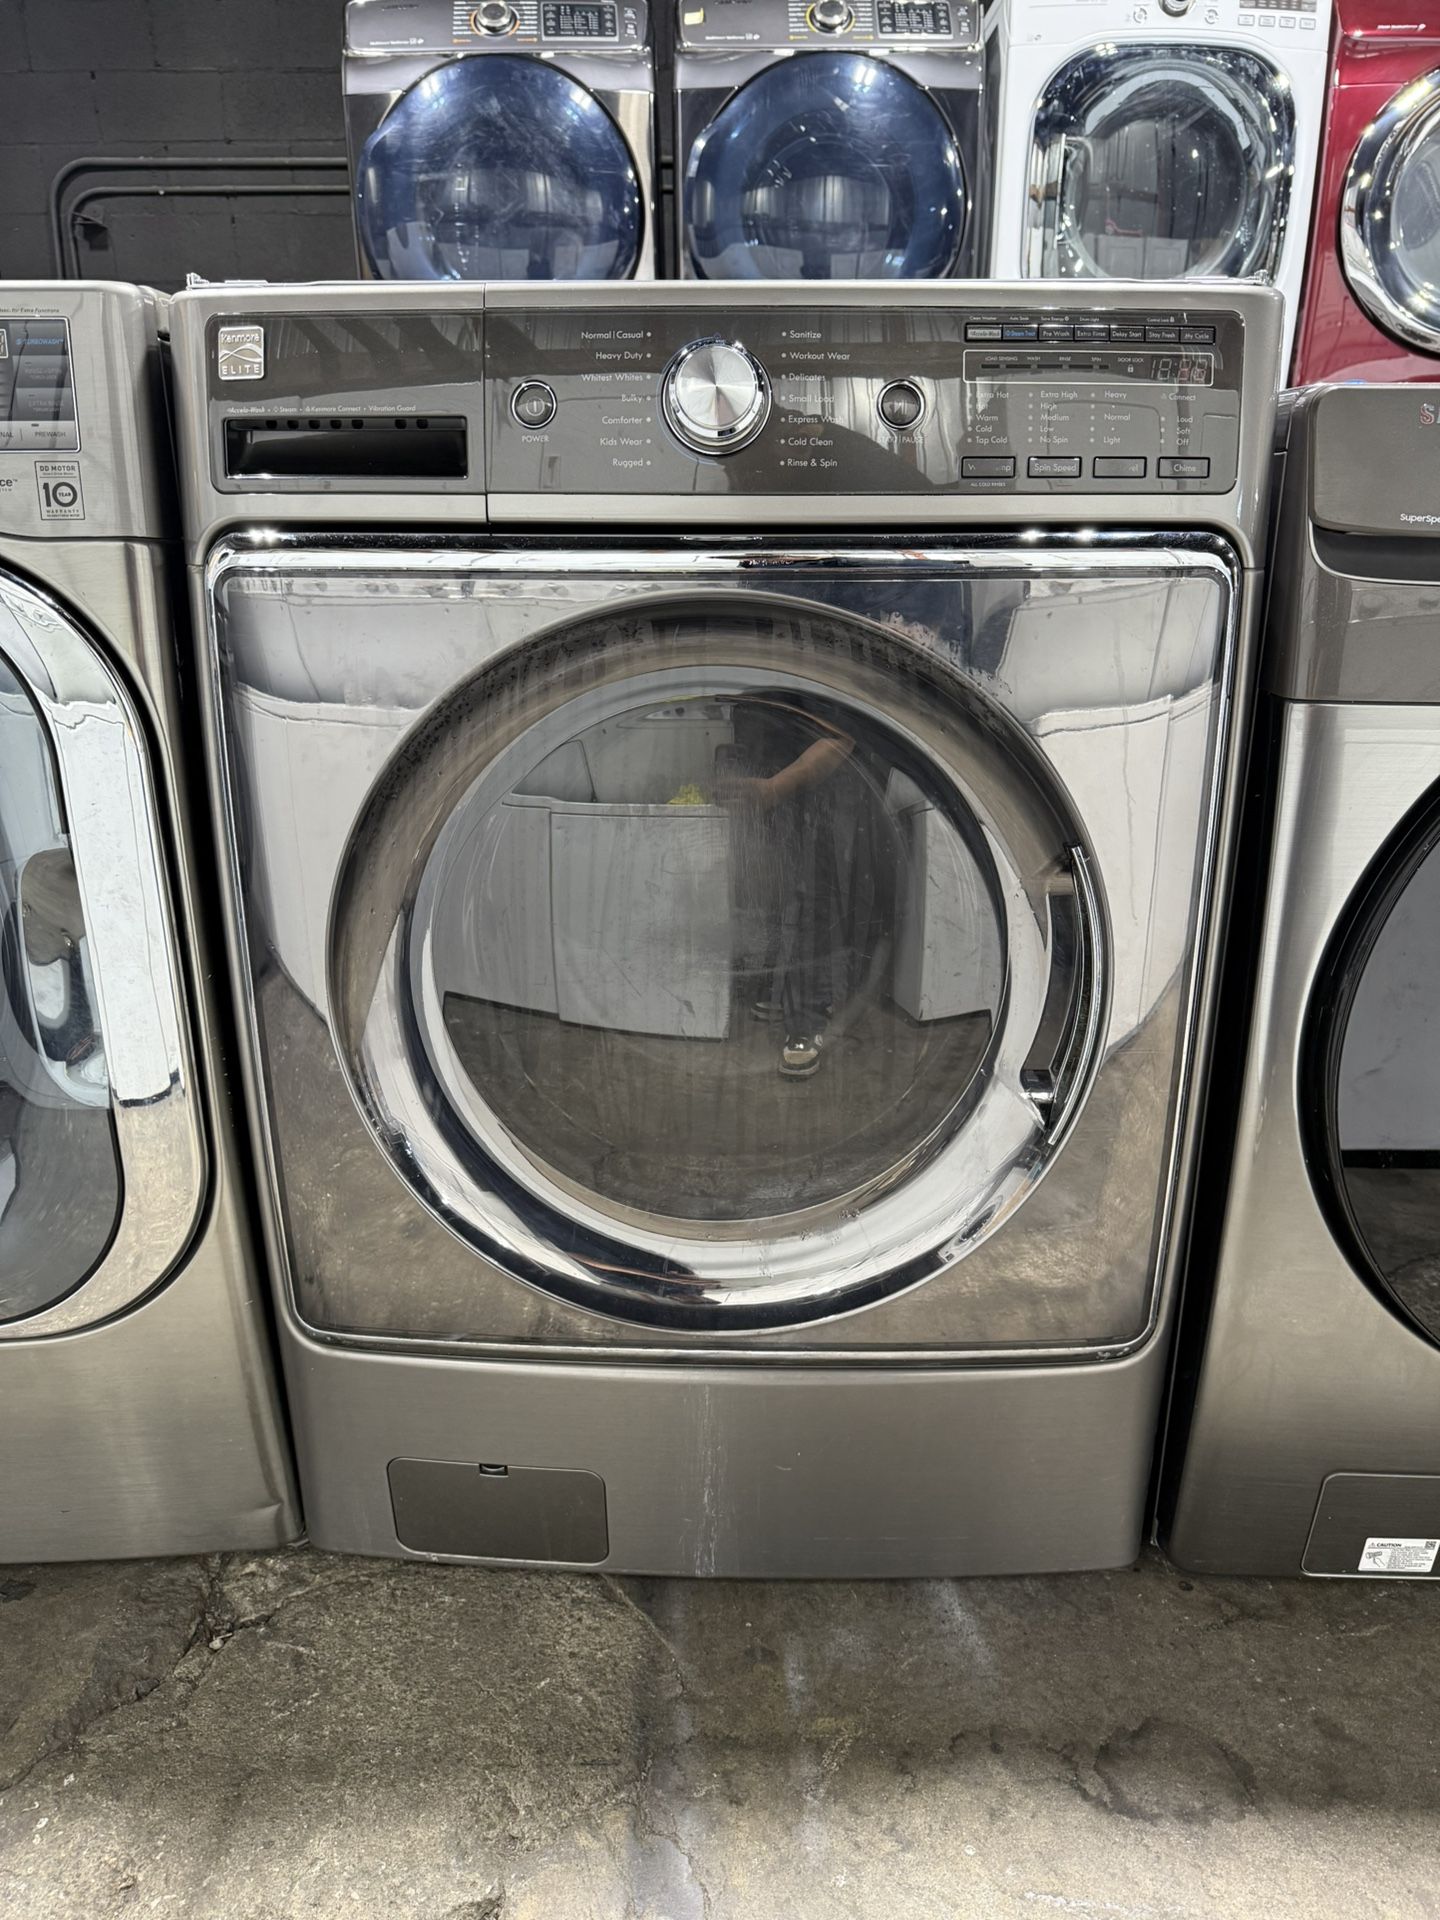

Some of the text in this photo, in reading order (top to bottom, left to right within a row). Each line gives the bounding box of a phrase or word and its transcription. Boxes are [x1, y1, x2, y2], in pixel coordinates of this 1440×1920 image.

[220, 333, 260, 343] Kenmore
[581, 330, 644, 339] Normal Casual
[790, 330, 822, 339] Sanitize
[595, 351, 643, 360] Heavy Duty
[790, 351, 850, 360] Workout Wear
[222, 364, 260, 375] ELITE
[614, 373, 643, 381] Whites
[789, 373, 826, 381] Delicates
[621, 394, 643, 403] Bulky
[789, 394, 812, 402] Small
[996, 391, 1009, 399] Hot
[1040, 390, 1078, 400] Extra High
[1104, 390, 1128, 399] Heavy
[1168, 392, 1197, 400] Connect
[1040, 402, 1058, 411] High
[602, 416, 643, 424] Comforter
[788, 415, 818, 424] Express
[1040, 413, 1070, 421] Medium
[1176, 415, 1194, 423] Loud
[975, 424, 993, 433] Cold
[1040, 424, 1055, 432] Low
[1176, 427, 1191, 435] Soft
[521, 435, 550, 443] POWER
[600, 437, 643, 446] Kids Wear
[788, 437, 833, 446] Cold Clean
[975, 435, 1008, 446] Tap Cold
[1039, 435, 1069, 445] No Spin
[1103, 435, 1121, 445] Light
[1176, 438, 1190, 446] Off
[612, 458, 644, 468] Rugged
[787, 459, 838, 469] Rinse & Spin
[1034, 463, 1077, 472] Spin Speed
[1173, 463, 1197, 472] Chime
[43, 482, 78, 507] 10
